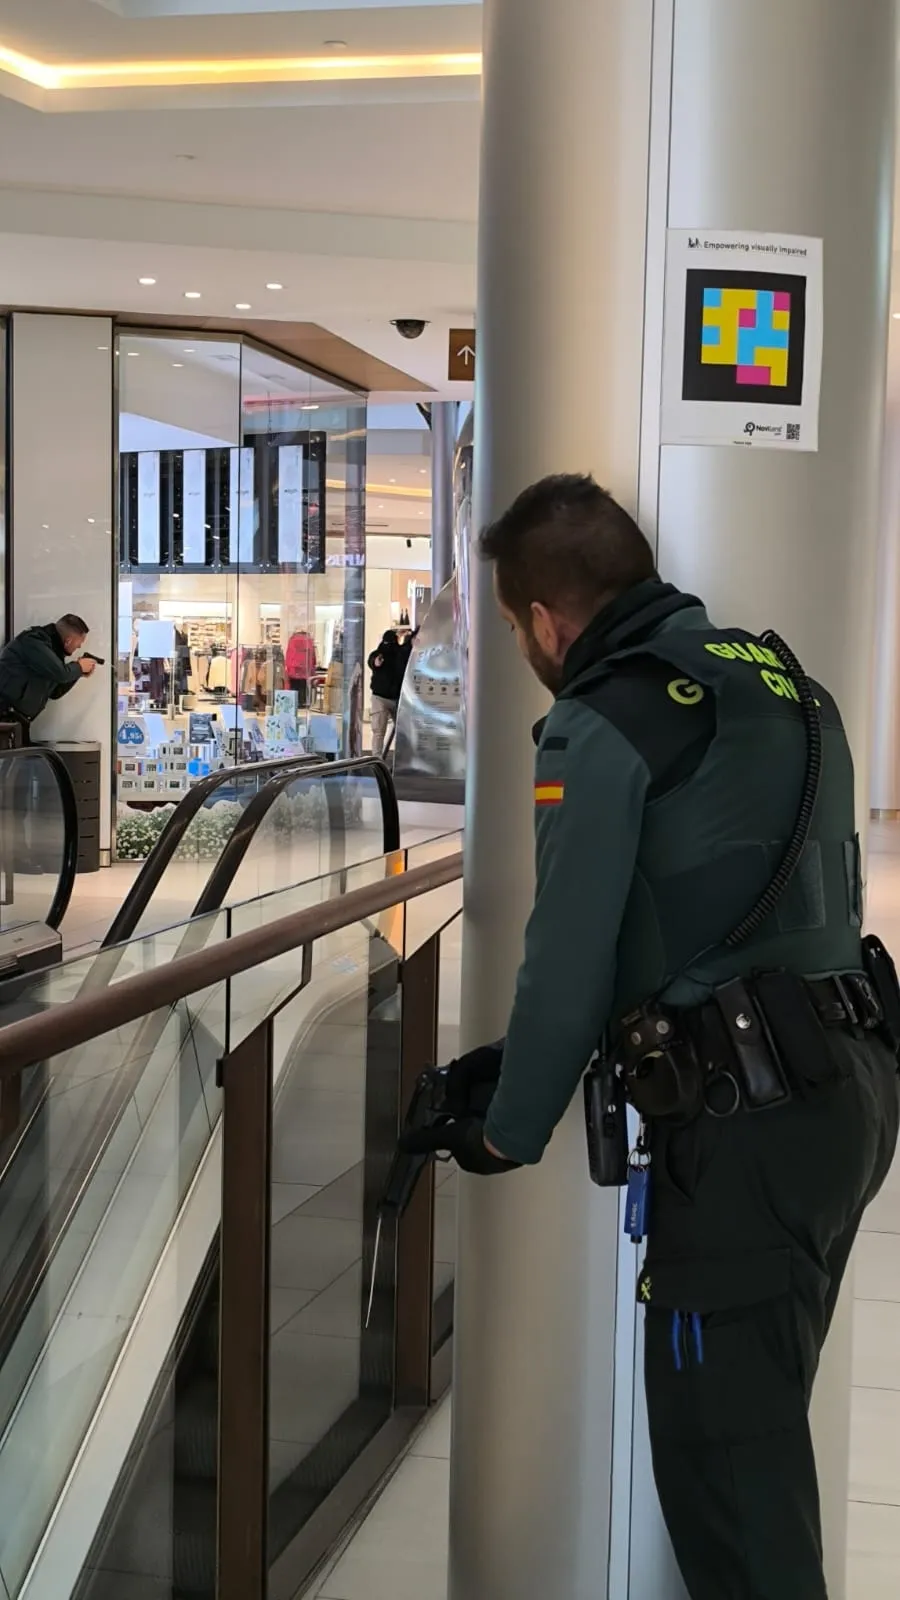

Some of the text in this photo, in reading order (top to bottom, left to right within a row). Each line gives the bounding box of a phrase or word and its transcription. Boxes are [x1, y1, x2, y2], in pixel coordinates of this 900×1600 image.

[704, 241, 807, 256] Empowering visually impaired
[667, 678, 704, 705] G
